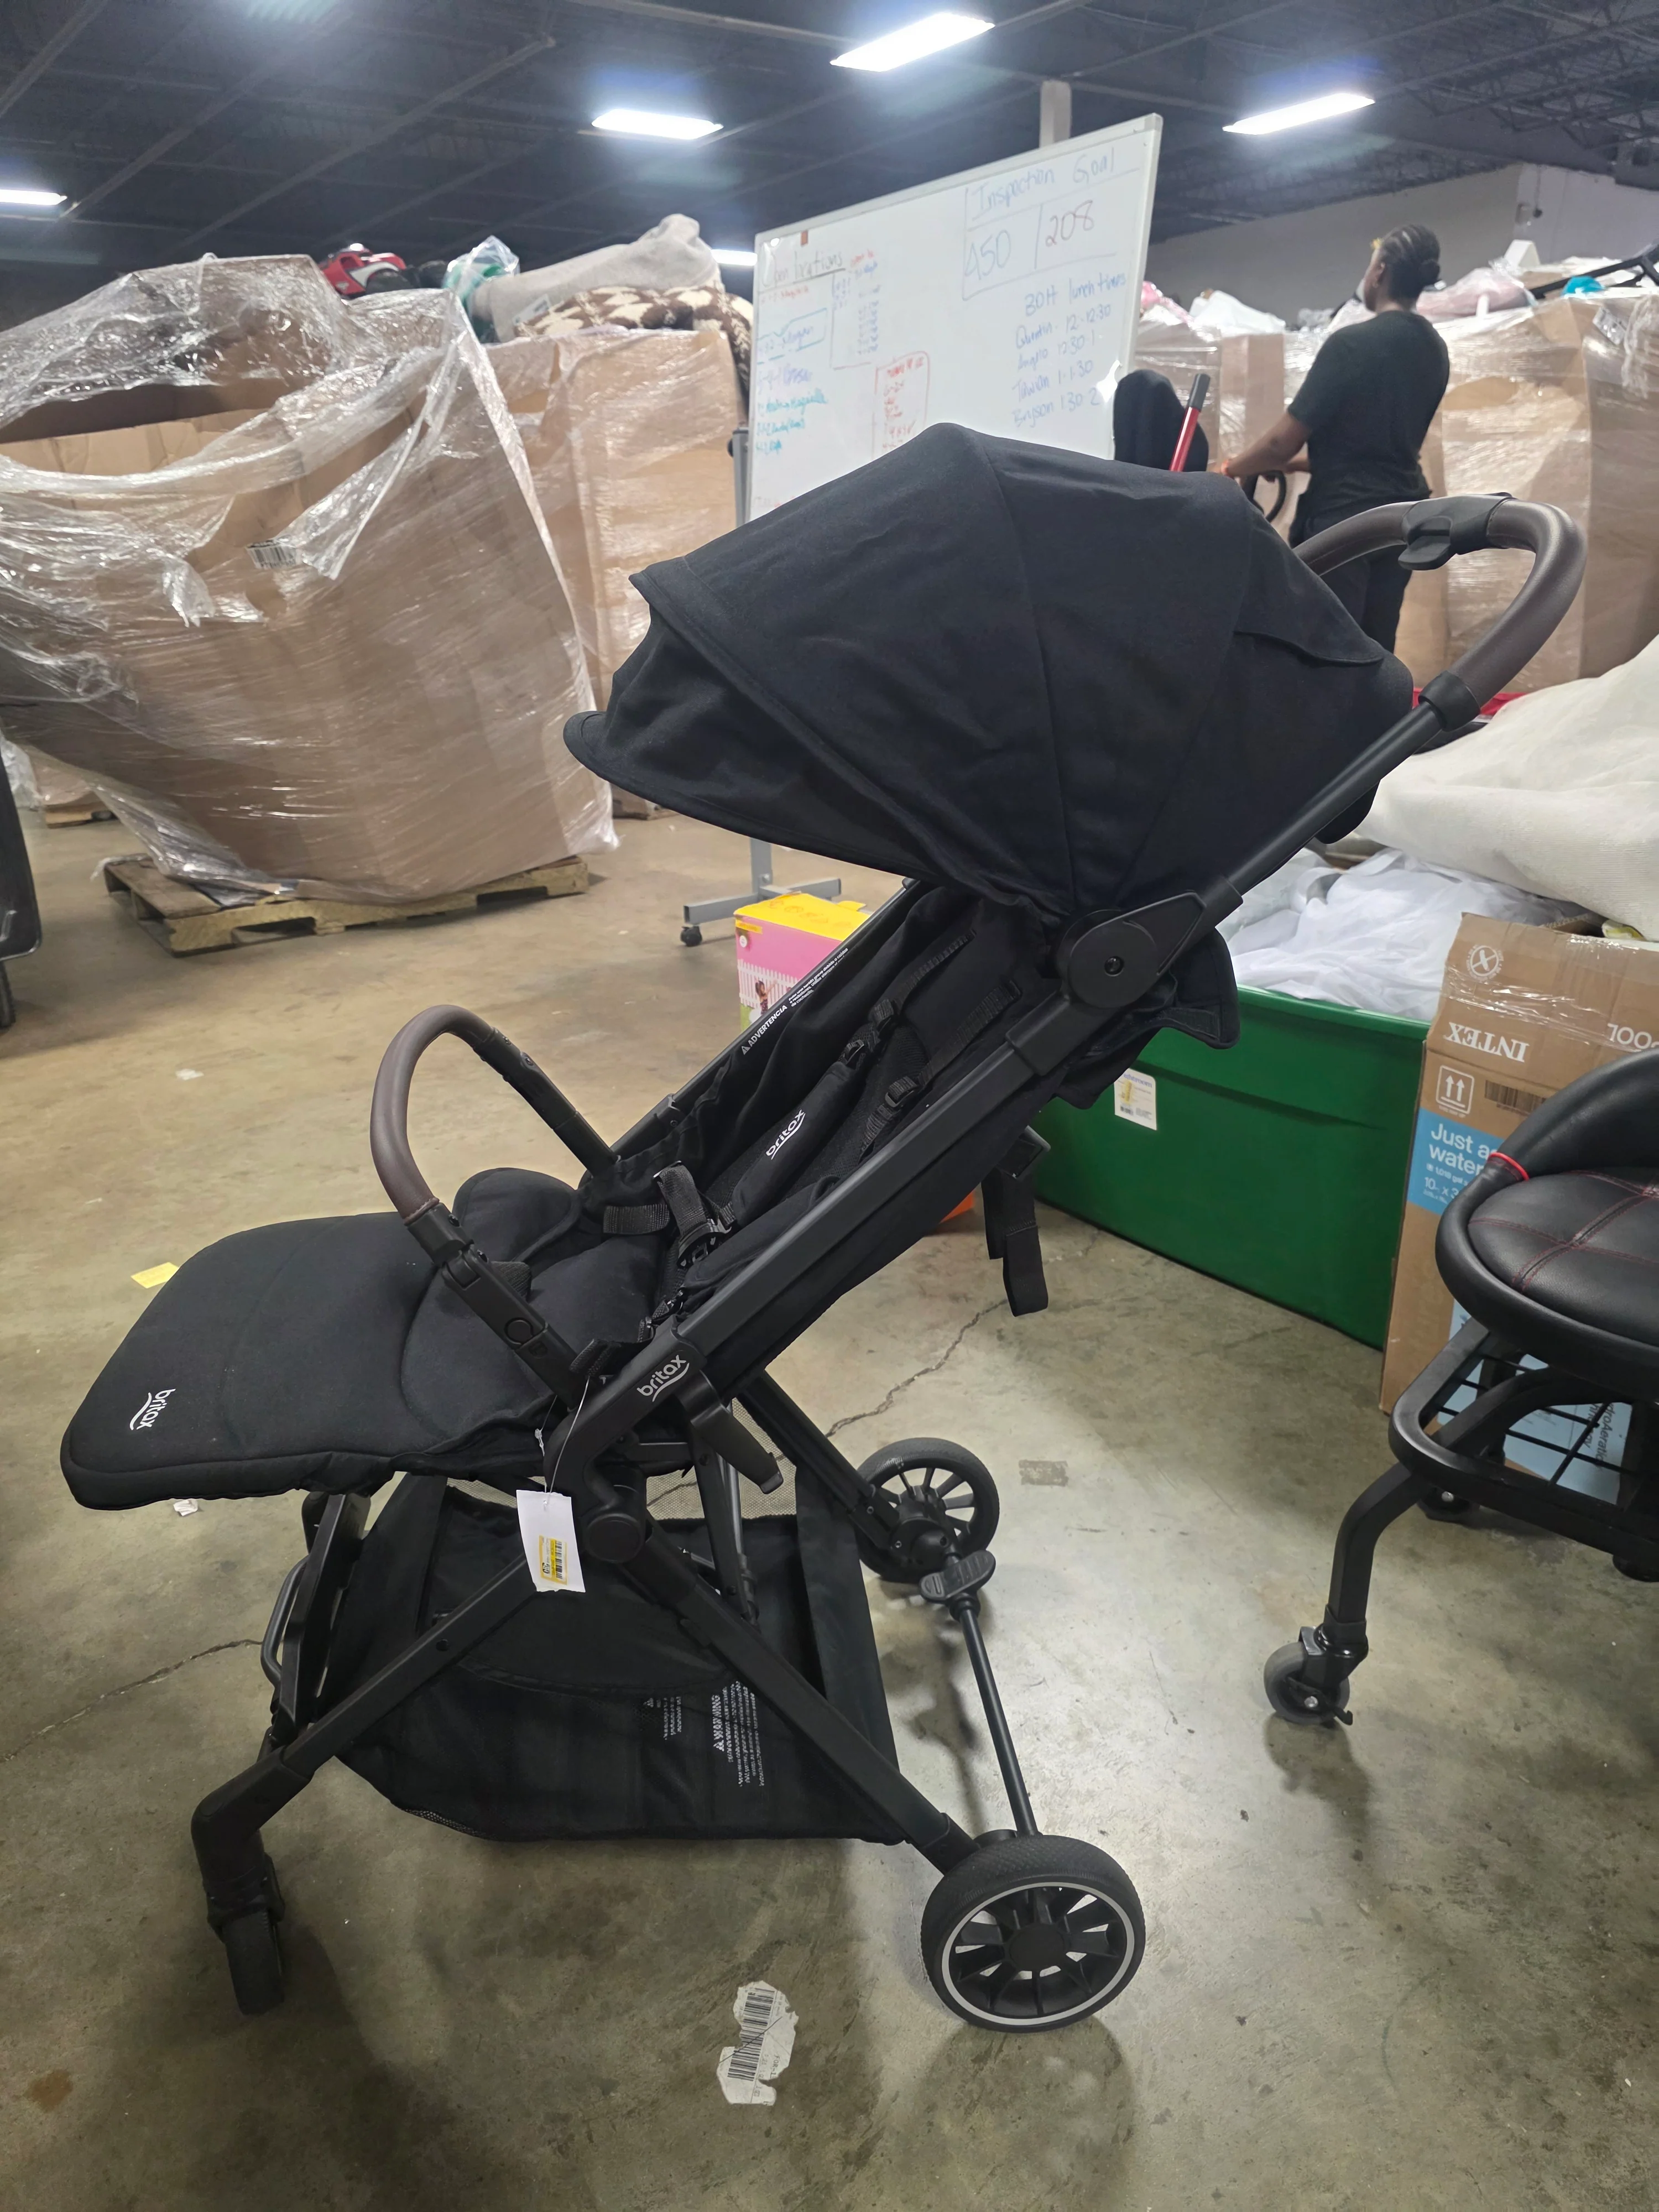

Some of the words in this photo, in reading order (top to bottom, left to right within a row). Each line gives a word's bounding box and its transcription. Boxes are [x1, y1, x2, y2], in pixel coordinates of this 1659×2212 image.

[1073, 147, 1114, 184] Goal
[1046, 199, 1094, 247] 208
[748, 1004, 787, 1047] ADVERTENCIA
[1444, 1022, 1530, 1063] INTEX
[1607, 1022, 1659, 1050] OOL
[1431, 1123, 1473, 1154] Just
[1429, 1144, 1485, 1176] water
[637, 1354, 689, 1399] britax
[135, 1388, 176, 1430] britax
